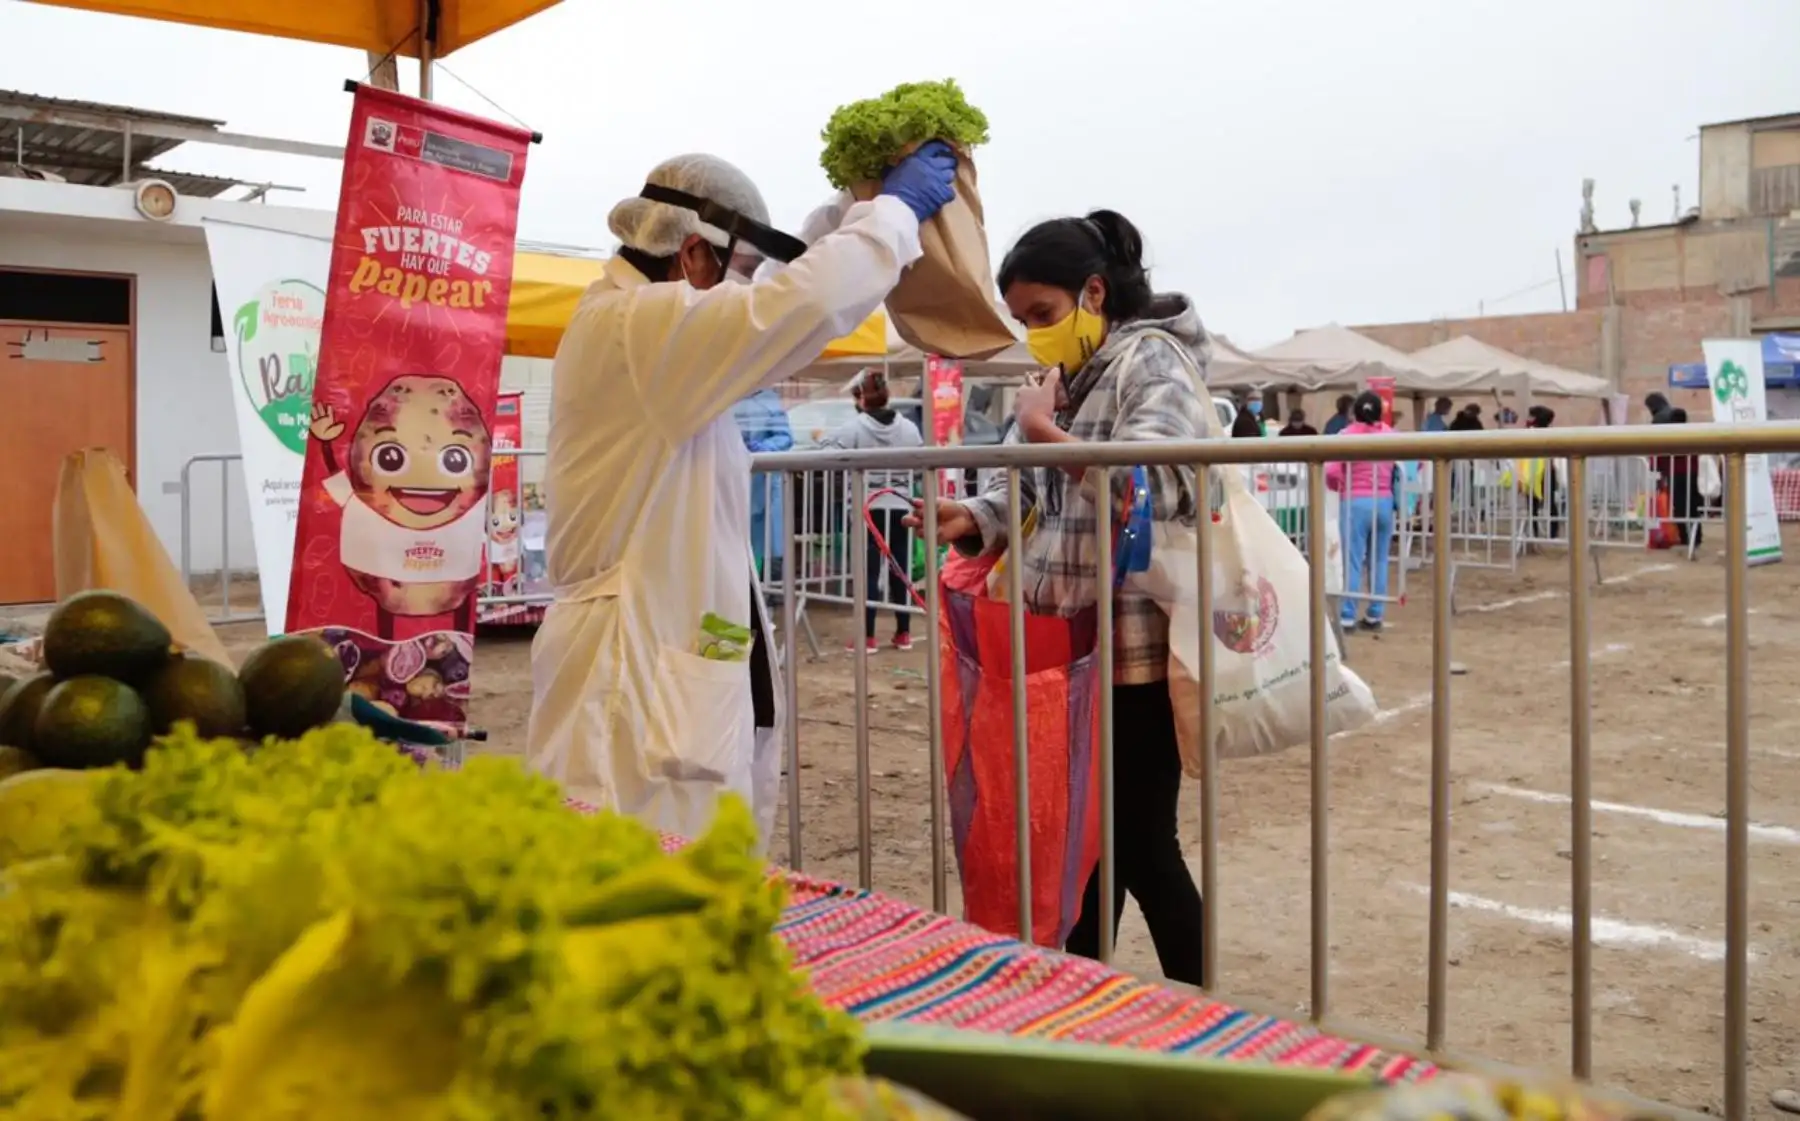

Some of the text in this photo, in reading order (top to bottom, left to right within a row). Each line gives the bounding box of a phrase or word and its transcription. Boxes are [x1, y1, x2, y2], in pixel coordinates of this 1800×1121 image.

[397, 206, 464, 233] PARA ESTAR
[361, 225, 493, 275] FUERTES
[400, 253, 451, 276] HAY QUE
[350, 256, 493, 309] papear
